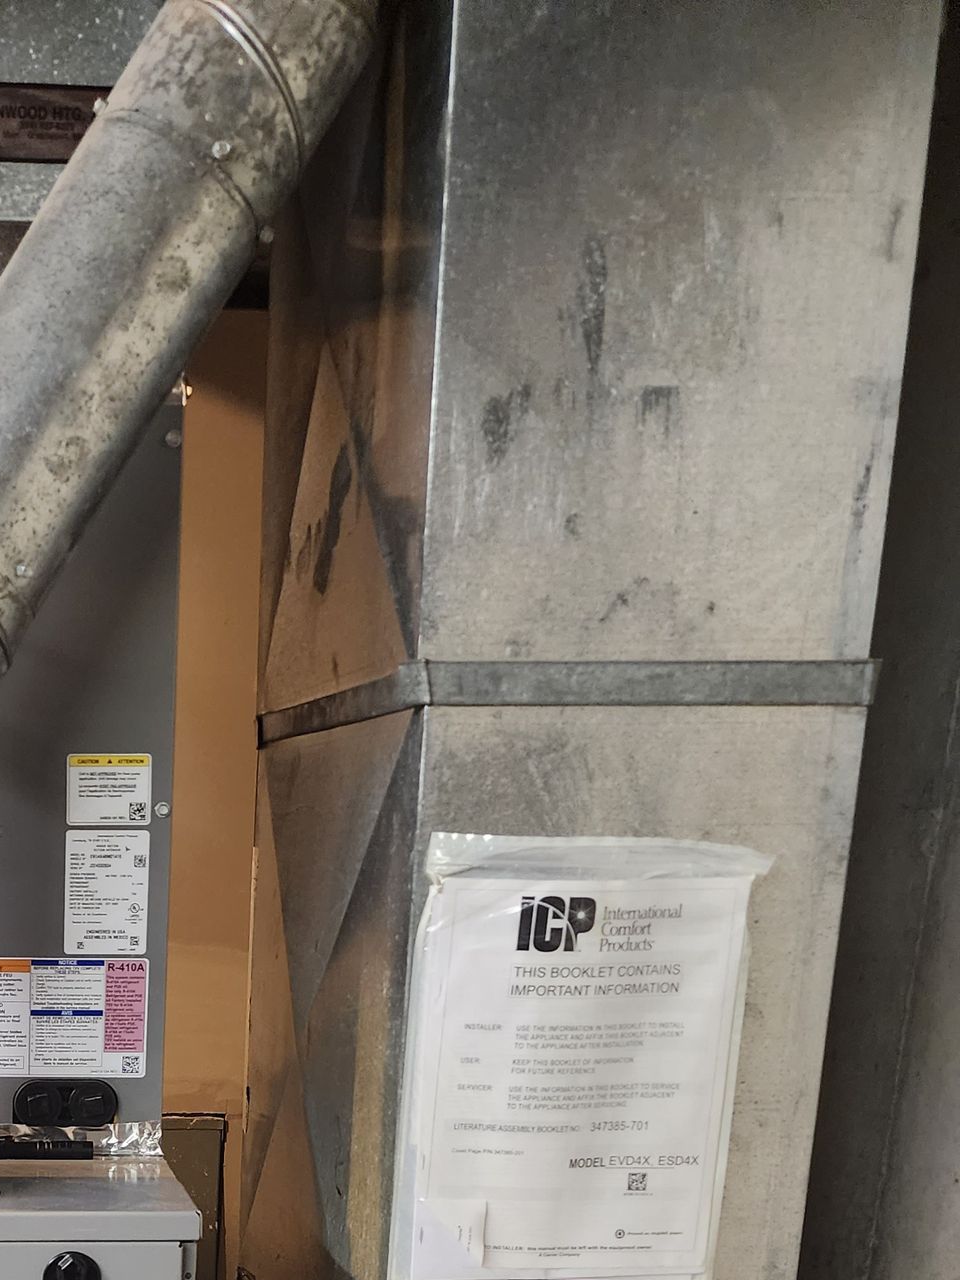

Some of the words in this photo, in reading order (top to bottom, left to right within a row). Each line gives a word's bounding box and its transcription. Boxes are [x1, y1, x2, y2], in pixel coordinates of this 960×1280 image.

[603, 904, 683, 920] International
[601, 920, 652, 936] Comfort
[599, 938, 653, 952] Products
[107, 963, 144, 972] R-410A
[514, 966, 546, 978] THIS
[550, 966, 613, 978] BOOKLET
[617, 964, 681, 977] CONTAINS
[510, 984, 590, 996] IMPORTANT
[594, 982, 679, 995] INFORMATION
[453, 1122, 497, 1132] LITERATURE
[498, 1124, 536, 1133] ASSEMBLY
[537, 1125, 569, 1134] BOOKLET
[589, 1120, 649, 1133] 347385-701
[568, 1157, 606, 1169] MODEL
[658, 1155, 700, 1166] ESD4X
